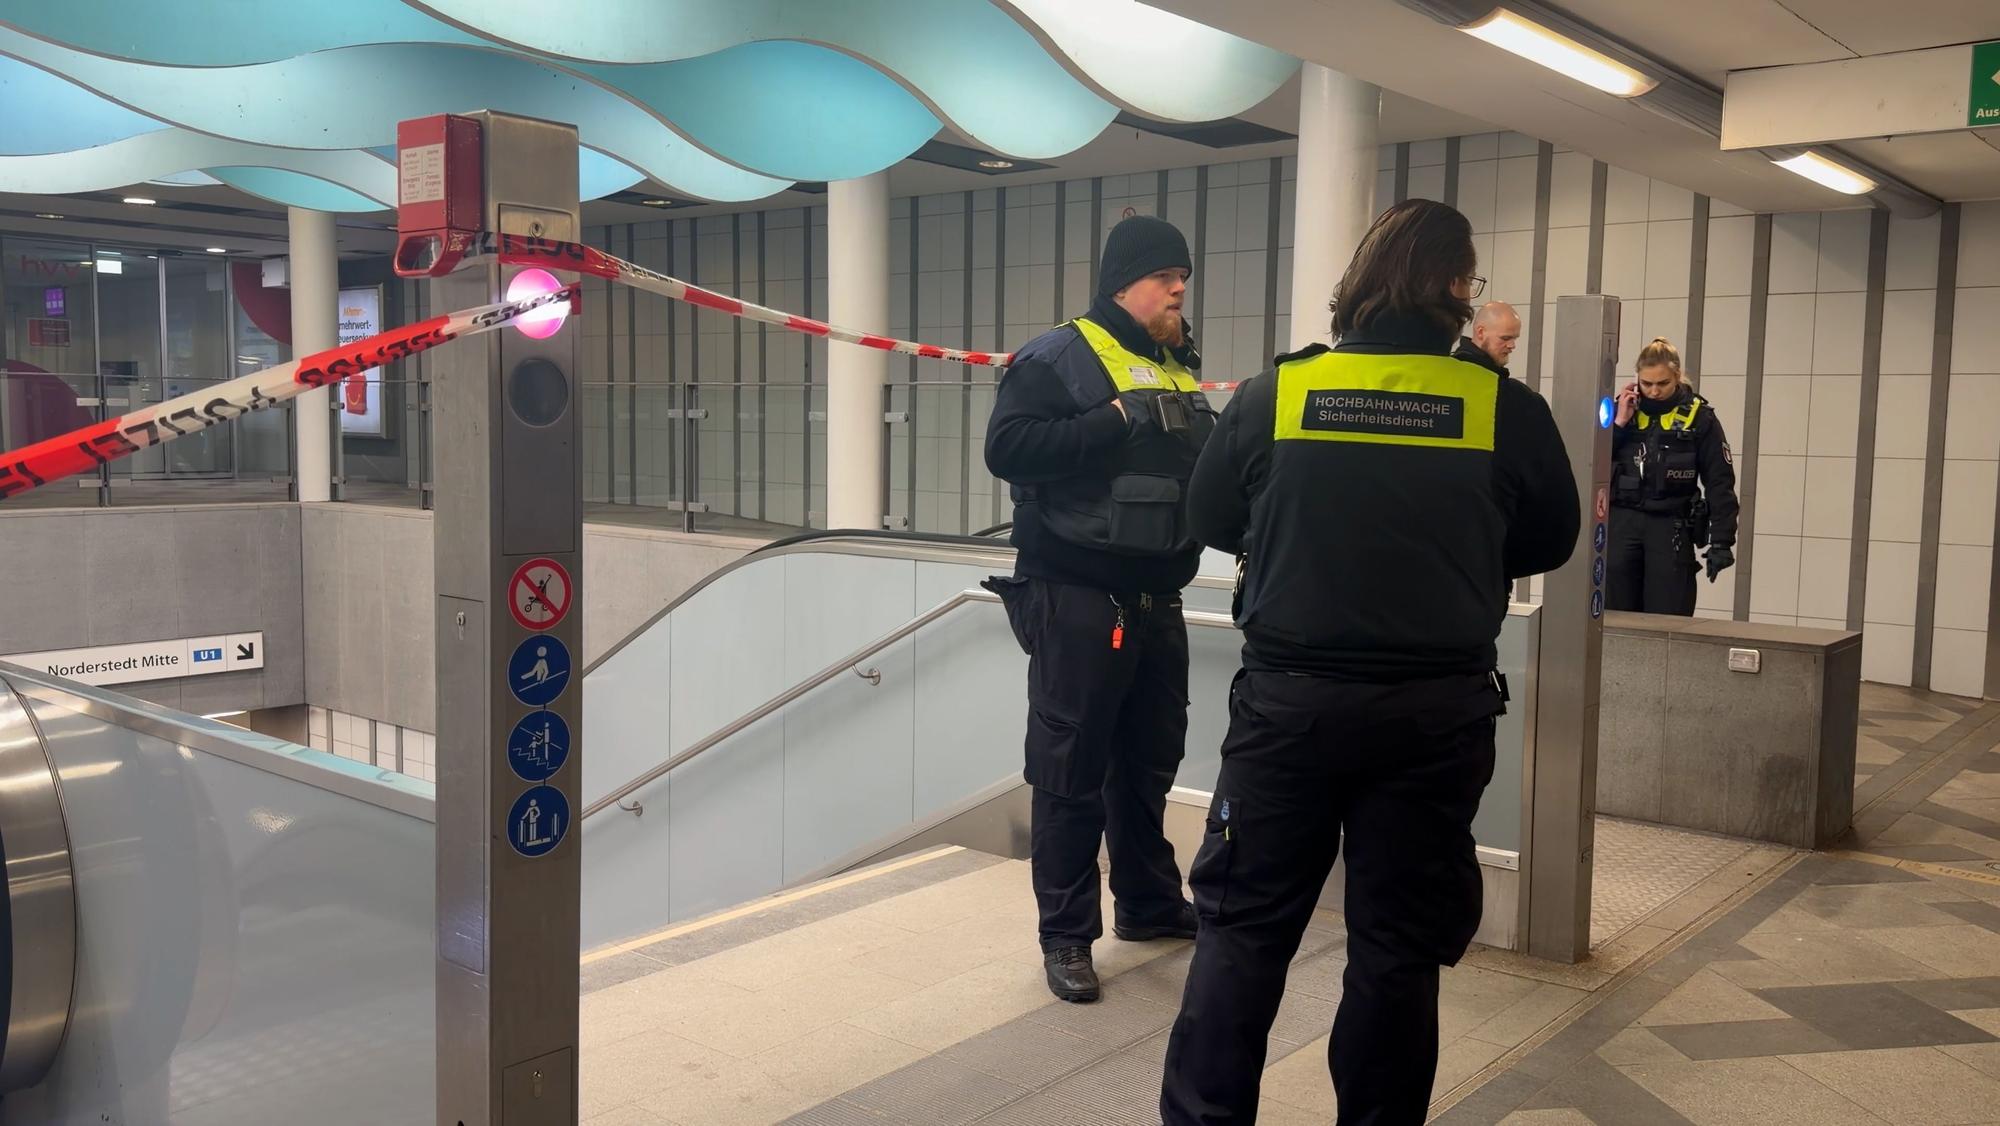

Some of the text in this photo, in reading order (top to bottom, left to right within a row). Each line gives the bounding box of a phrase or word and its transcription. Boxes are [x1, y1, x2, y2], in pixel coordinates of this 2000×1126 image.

[1315, 397, 1450, 415] HOCHBAHN-WACHE
[1318, 410, 1434, 428] Sicherheitsdienst
[1666, 469, 1696, 479] POLIZEI
[47, 650, 216, 676] Norderstedt Mitte U1
